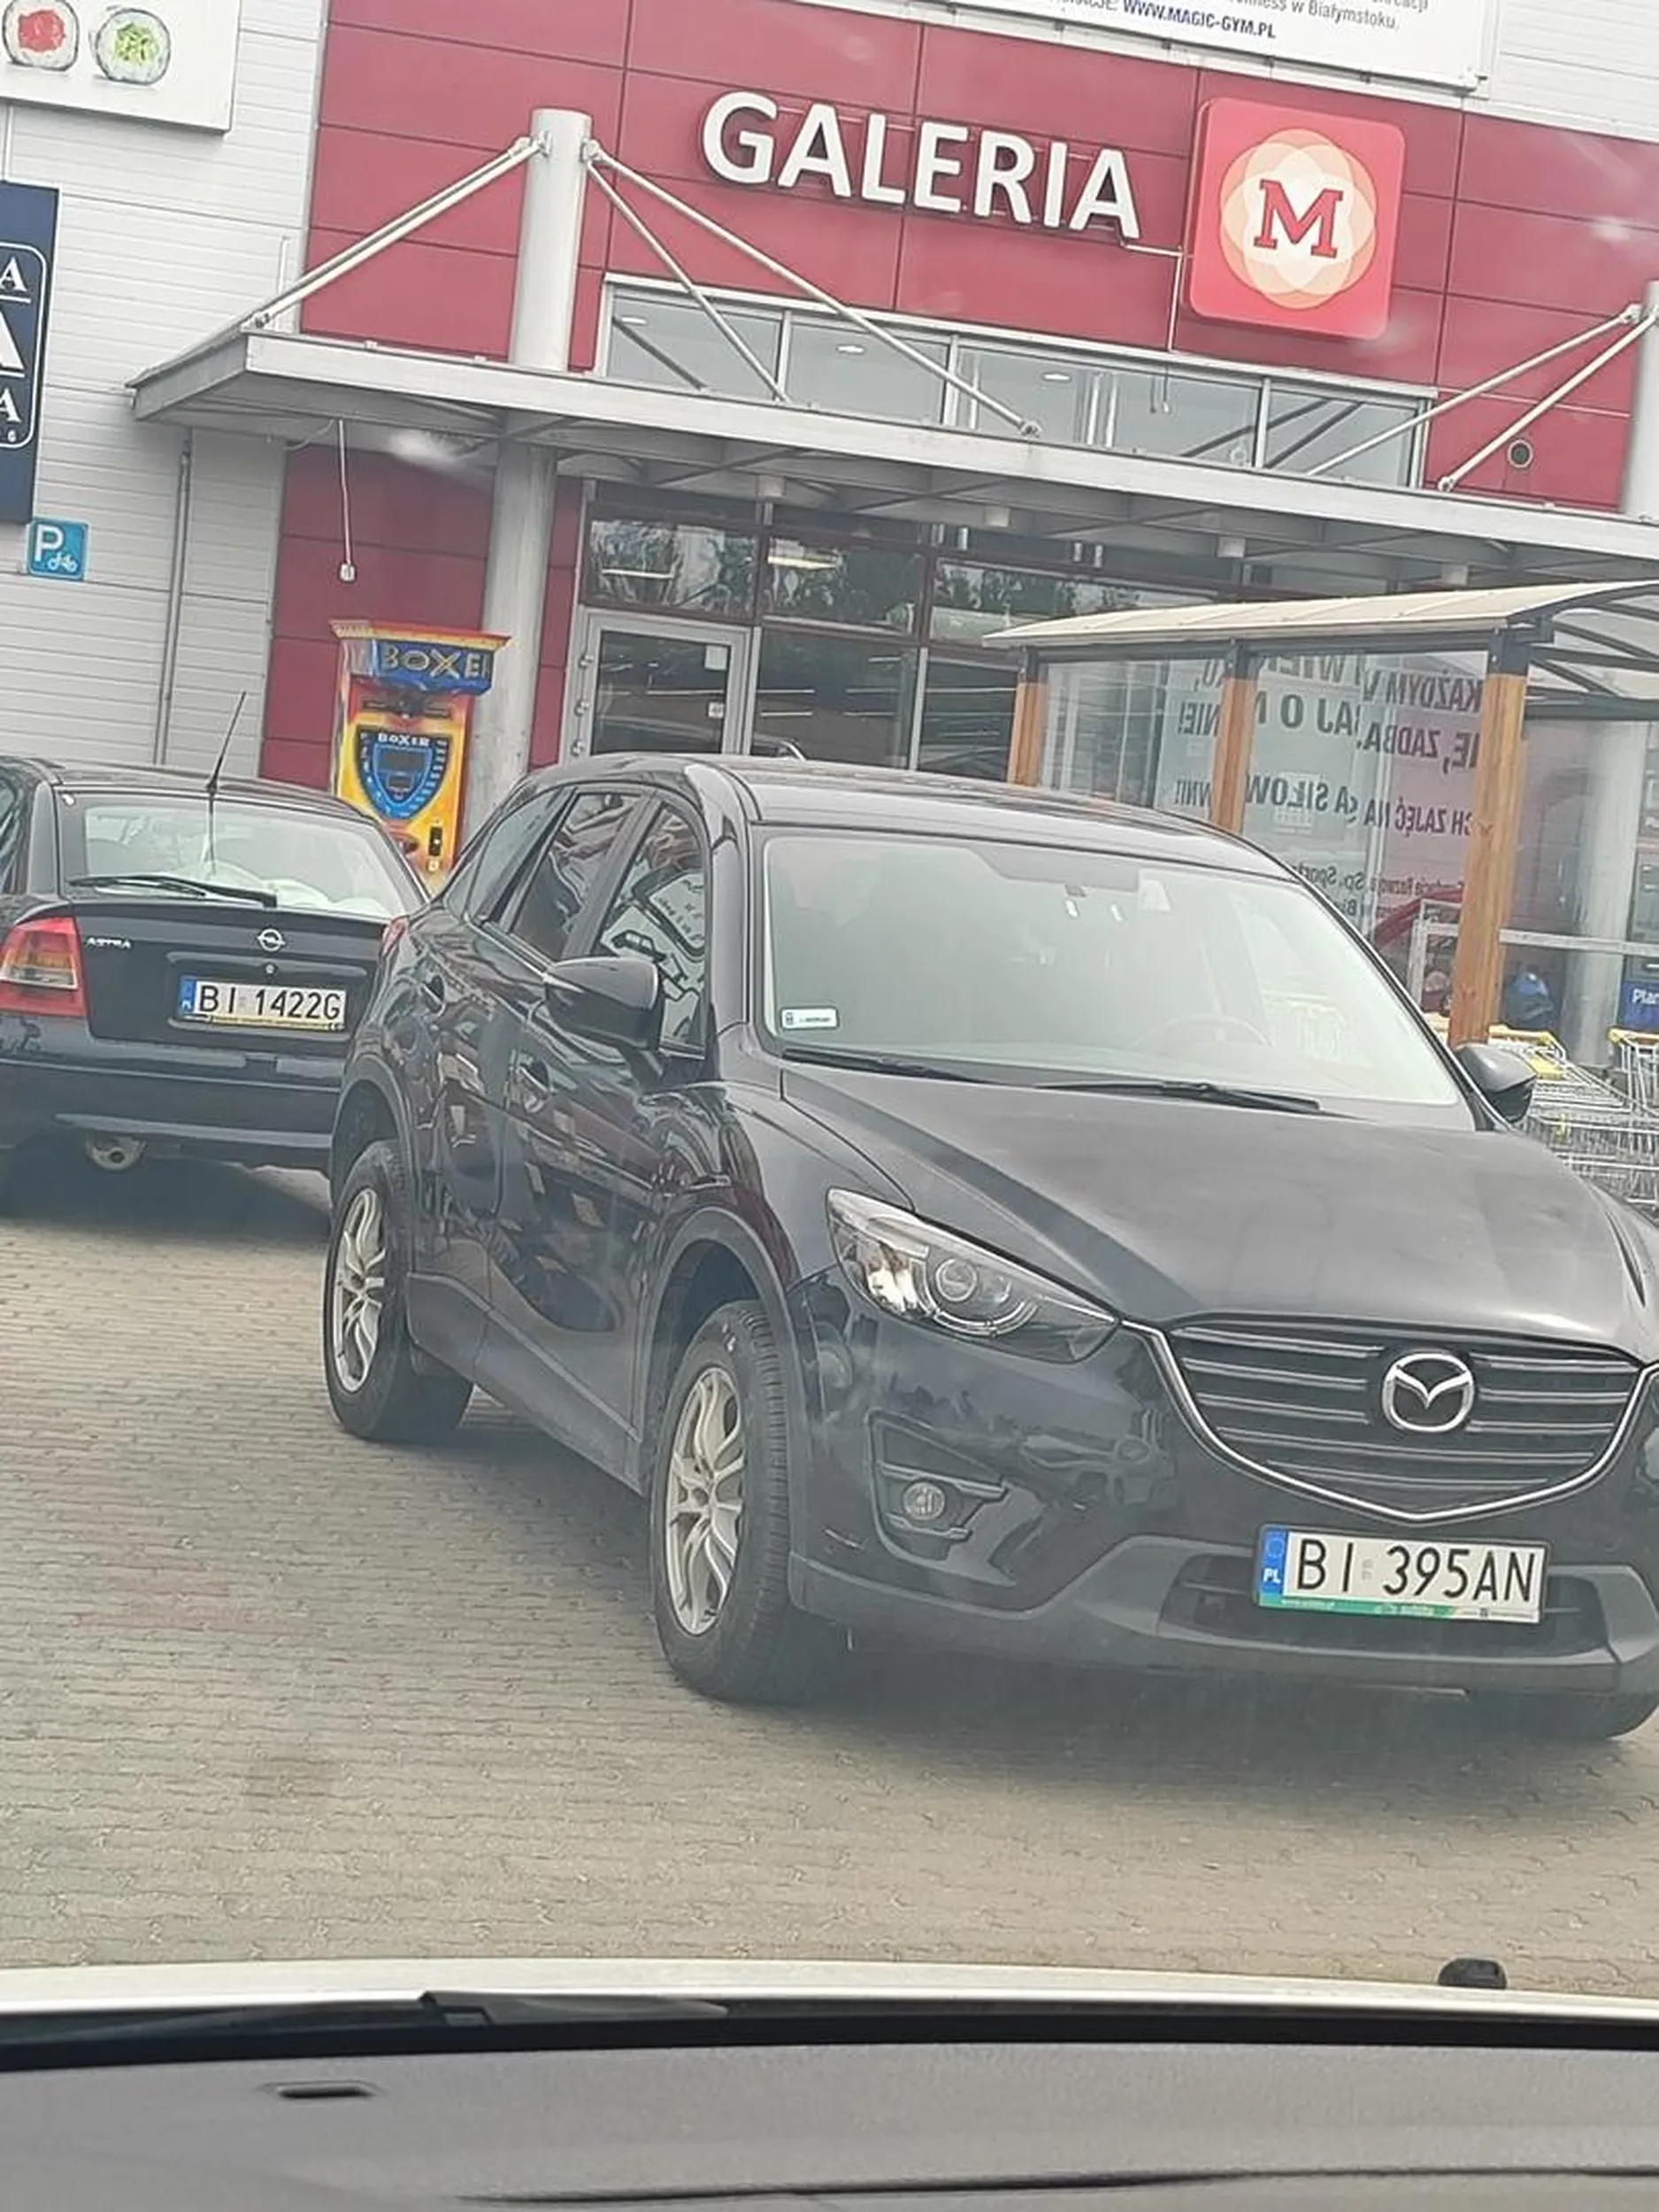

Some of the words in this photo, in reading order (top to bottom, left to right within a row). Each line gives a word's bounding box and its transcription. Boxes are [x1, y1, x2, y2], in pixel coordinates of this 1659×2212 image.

[1291, 0, 1305, 13] w
[703, 90, 1140, 239] GALERIA
[1253, 179, 1344, 259] M
[34, 525, 64, 563] P
[384, 645, 491, 679] BOXE
[199, 984, 235, 1015] BI
[255, 990, 342, 1019] 1422G
[1263, 1568, 1281, 1584] PL
[1297, 1539, 1355, 1593] BI
[1383, 1545, 1536, 1602] 395AN
